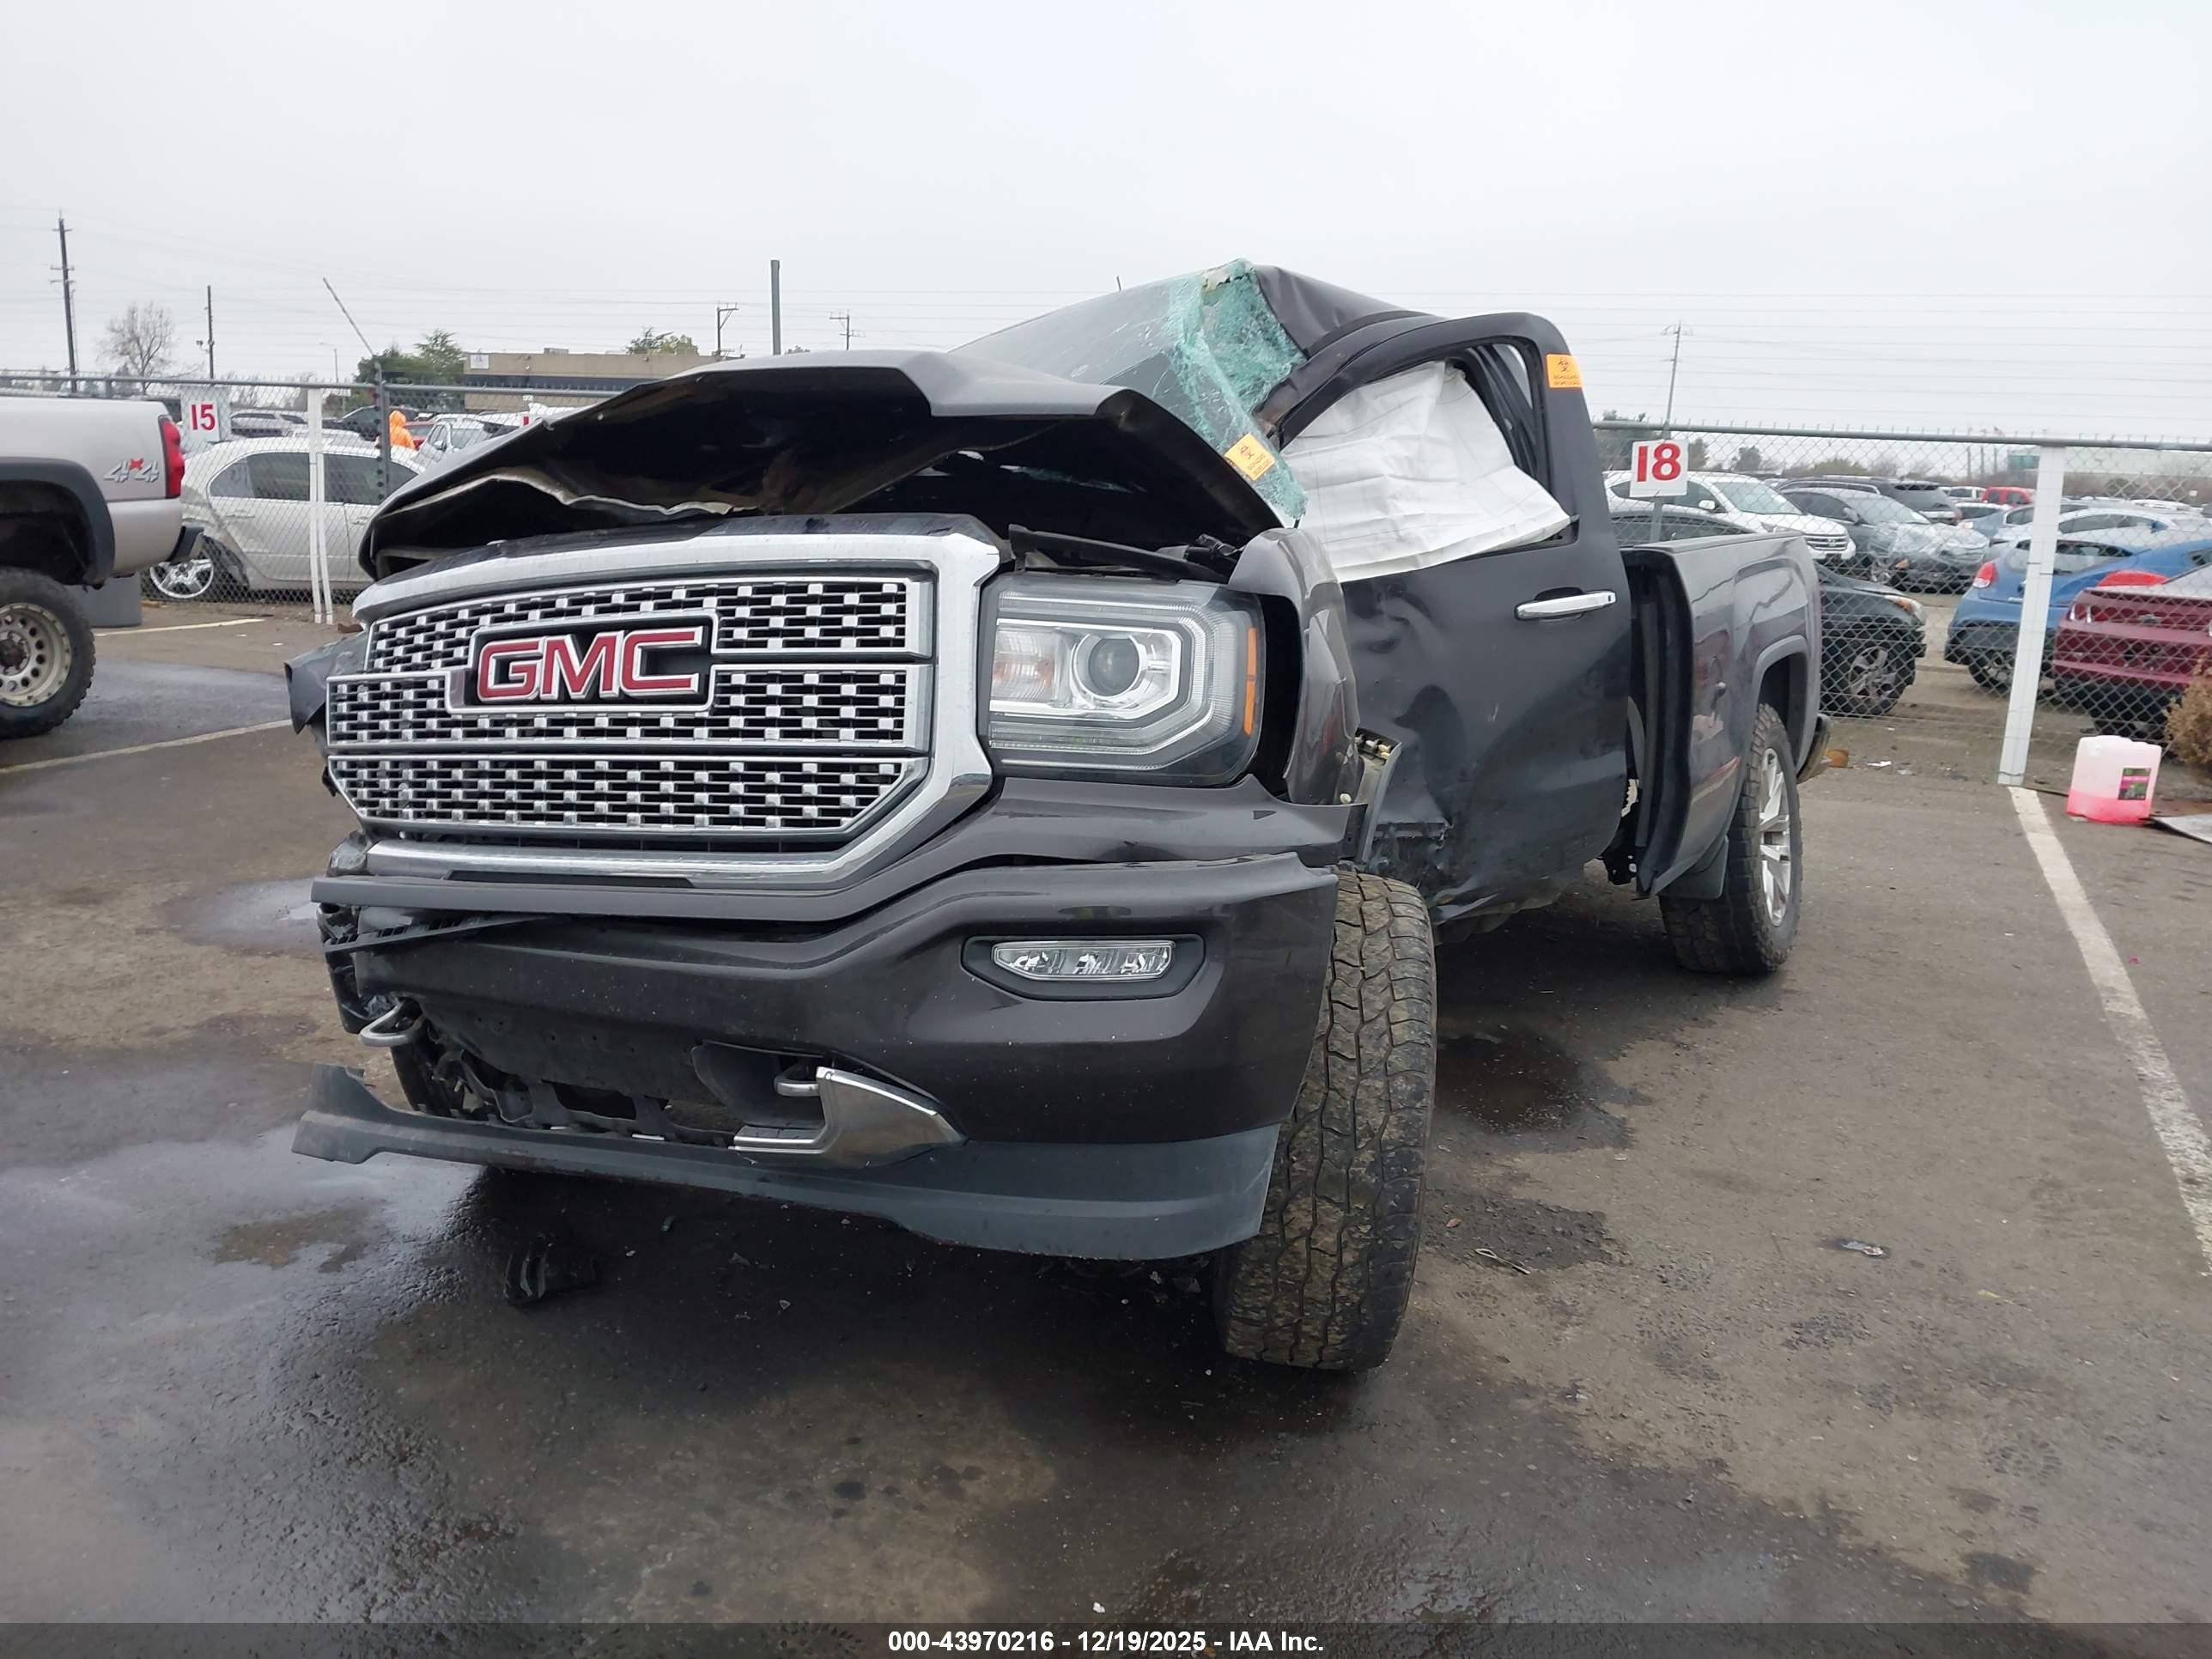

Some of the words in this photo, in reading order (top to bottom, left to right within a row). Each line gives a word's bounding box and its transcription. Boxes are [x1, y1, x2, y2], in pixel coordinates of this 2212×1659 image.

[191, 404, 216, 431] 15
[1636, 442, 1681, 483] 18
[477, 626, 702, 702] GMC
